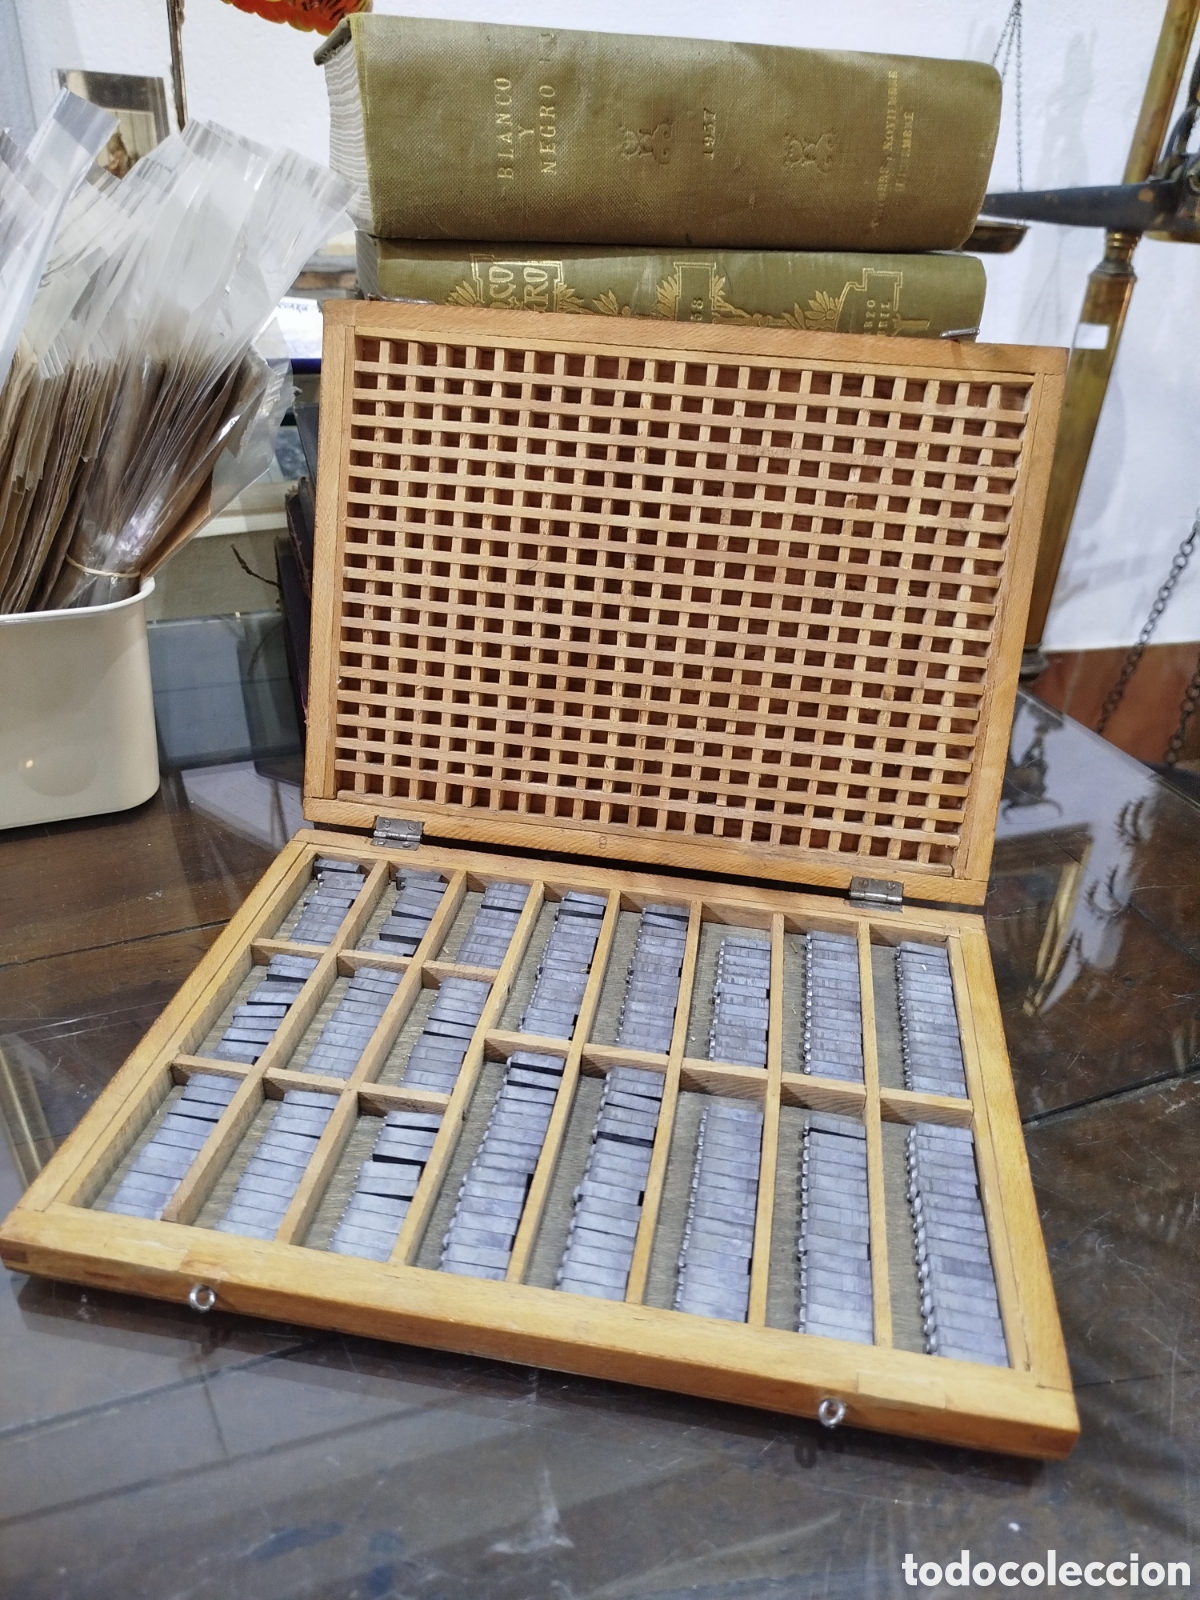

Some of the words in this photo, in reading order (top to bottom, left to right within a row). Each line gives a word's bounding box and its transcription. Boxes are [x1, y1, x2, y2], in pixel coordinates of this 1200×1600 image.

[494, 77, 514, 180] BLANCO
[518, 125, 535, 141] Y
[539, 84, 557, 175] NEGRO
[863, 299, 876, 334] RZO
